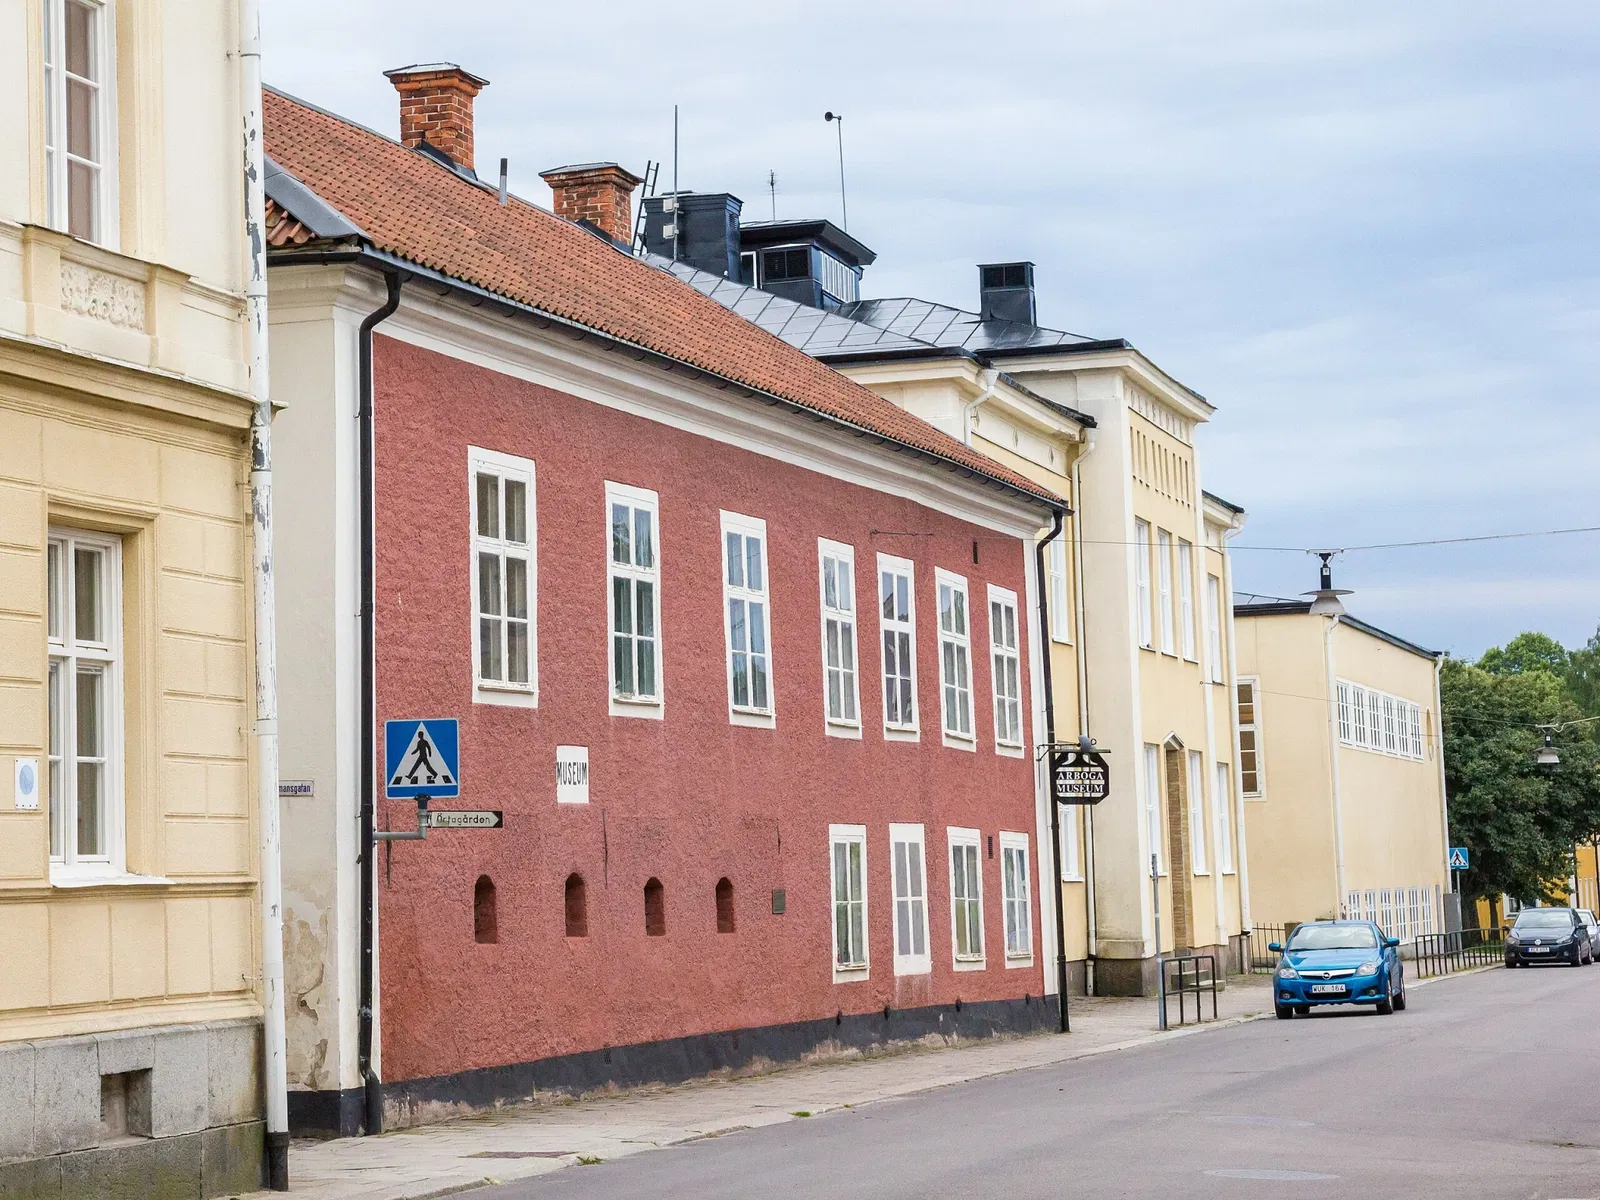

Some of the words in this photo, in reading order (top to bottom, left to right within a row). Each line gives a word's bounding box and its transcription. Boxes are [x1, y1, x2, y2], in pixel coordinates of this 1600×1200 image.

[556, 762, 588, 785] MUSEUM
[1058, 771, 1104, 780] ARBOGA
[1057, 784, 1104, 793] MUSEUM
